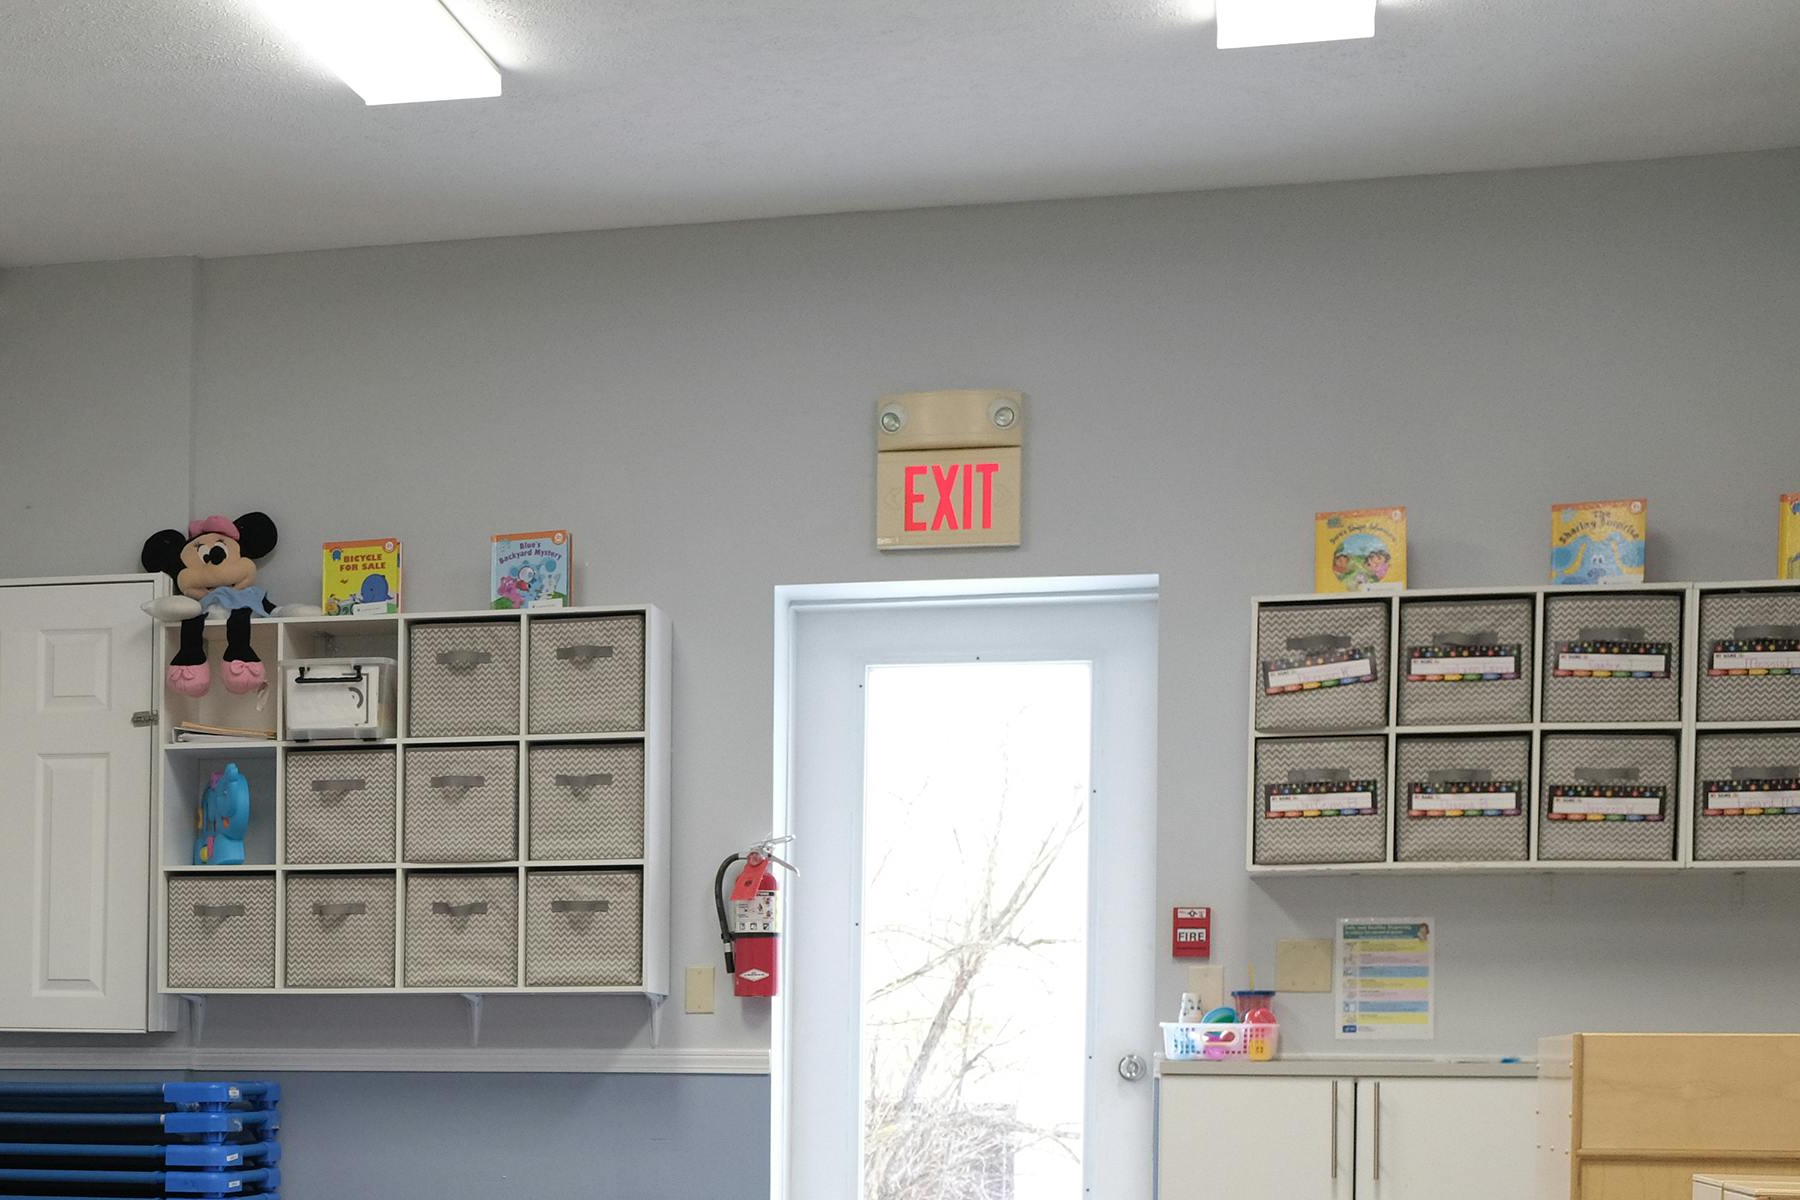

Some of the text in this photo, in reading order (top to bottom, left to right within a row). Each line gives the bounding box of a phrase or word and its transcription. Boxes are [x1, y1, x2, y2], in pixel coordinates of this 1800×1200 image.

[904, 463, 999, 532] EXIT
[343, 553, 383, 563] BICYCLE
[340, 562, 386, 571] FOR SALE
[1179, 932, 1205, 943] FIRE
